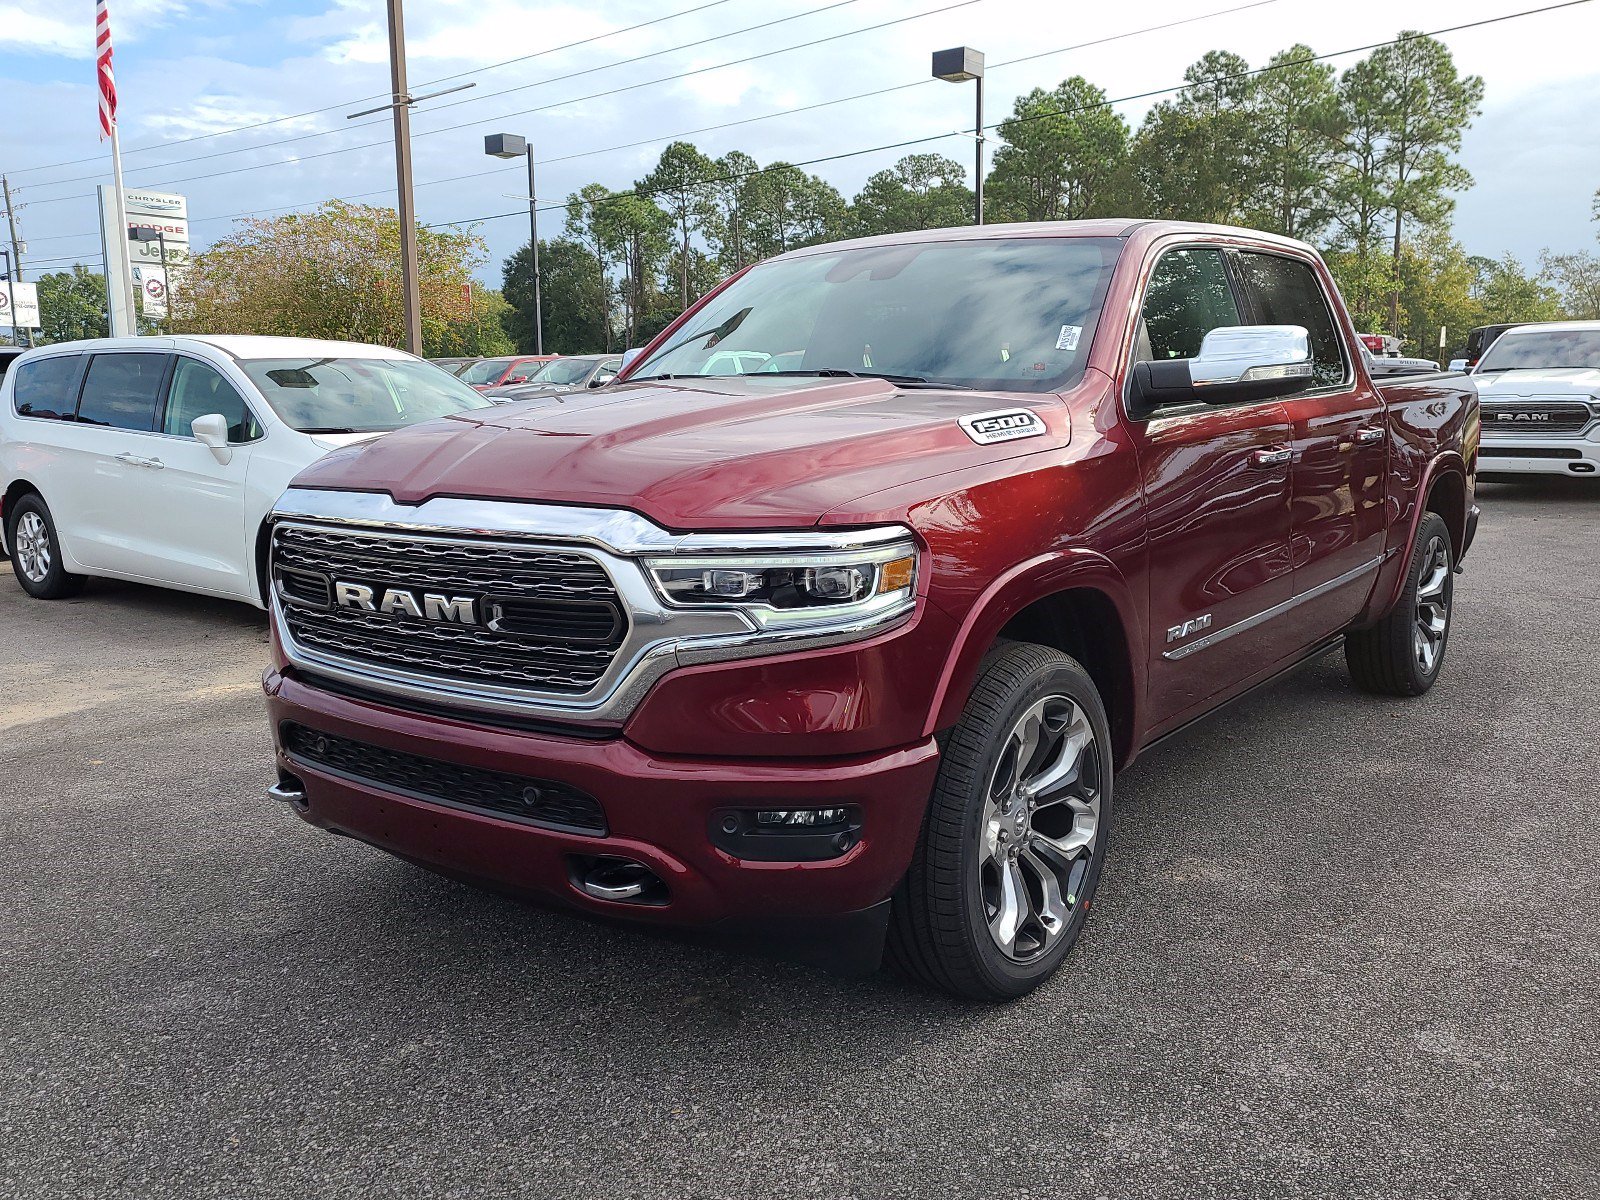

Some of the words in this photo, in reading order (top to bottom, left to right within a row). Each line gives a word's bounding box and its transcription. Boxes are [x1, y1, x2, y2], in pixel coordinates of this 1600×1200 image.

[127, 194, 181, 206] CHRYSLER
[128, 221, 185, 235] DODGE
[972, 414, 1031, 433] 1500
[1497, 413, 1549, 421] RAM
[335, 581, 477, 625] RAM
[1166, 613, 1212, 643] RAM
